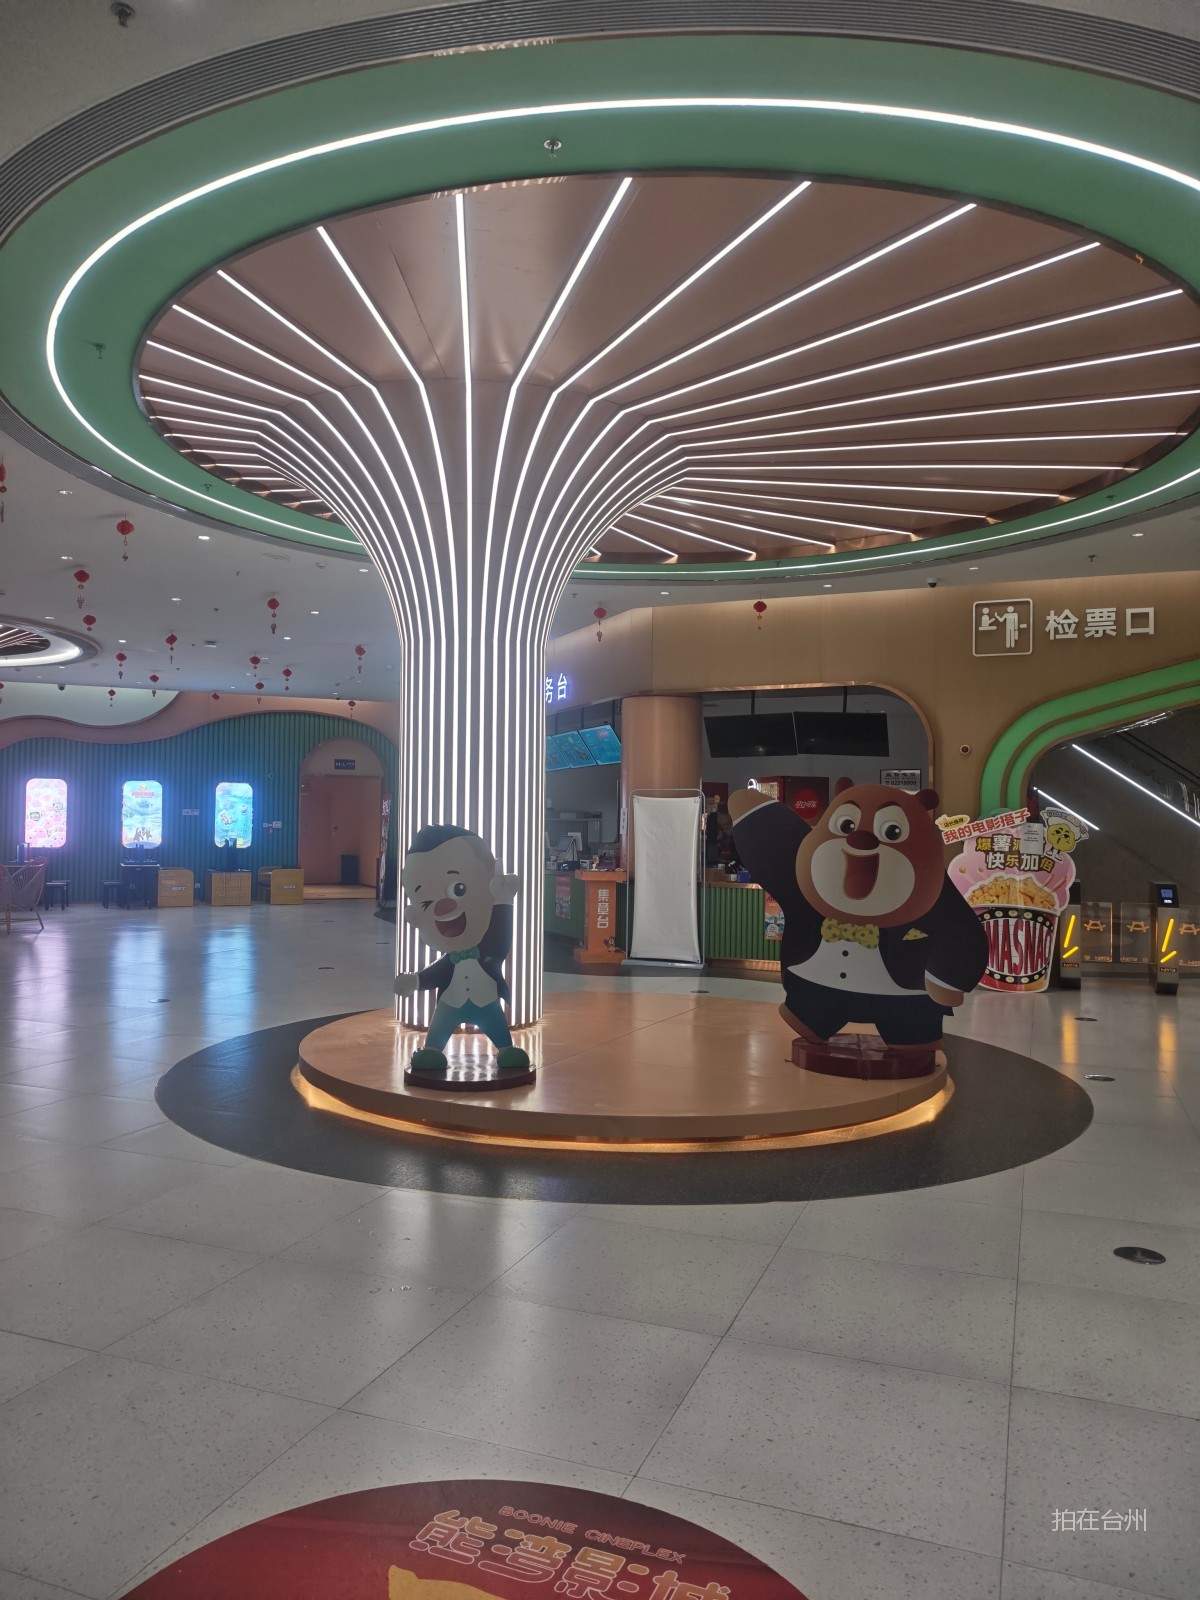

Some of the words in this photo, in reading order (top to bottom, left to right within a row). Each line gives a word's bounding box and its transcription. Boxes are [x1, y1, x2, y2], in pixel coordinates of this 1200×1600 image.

[1045, 607, 1155, 640] 检票口
[499, 1506, 578, 1535] BOONIE
[585, 1530, 687, 1565] CINEPLEX
